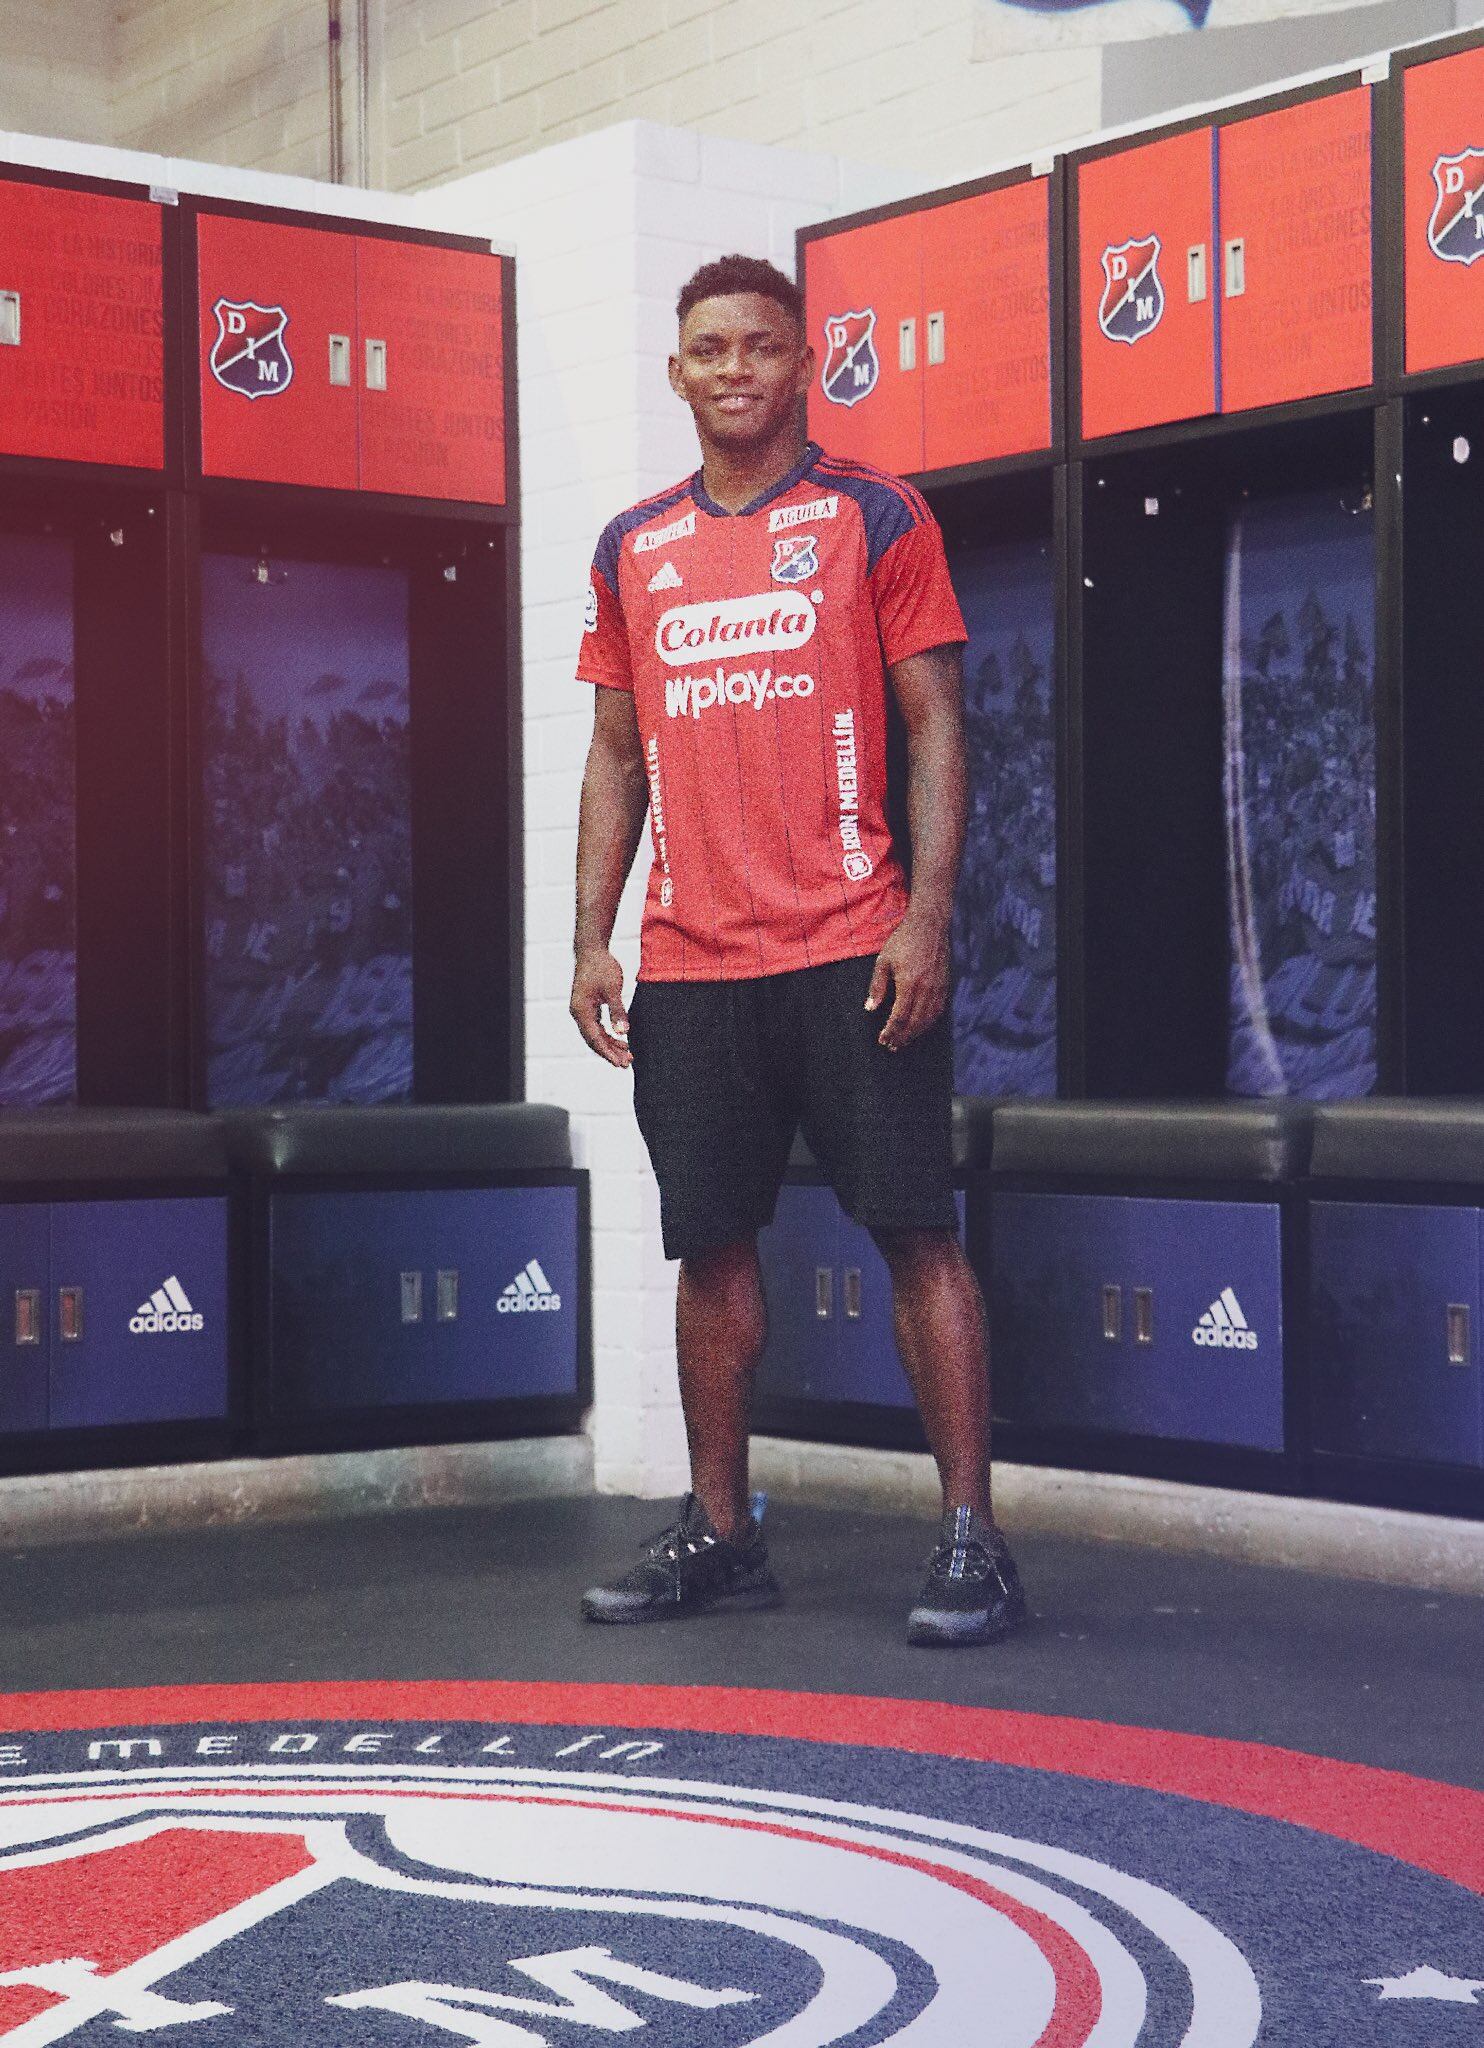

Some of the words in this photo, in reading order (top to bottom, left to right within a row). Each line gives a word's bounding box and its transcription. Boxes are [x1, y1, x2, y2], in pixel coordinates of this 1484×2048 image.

[661, 608, 809, 651] Colanta
[496, 1292, 562, 1313] adidas
[129, 1311, 204, 1333] adidas
[1192, 1324, 1258, 1350] adidas
